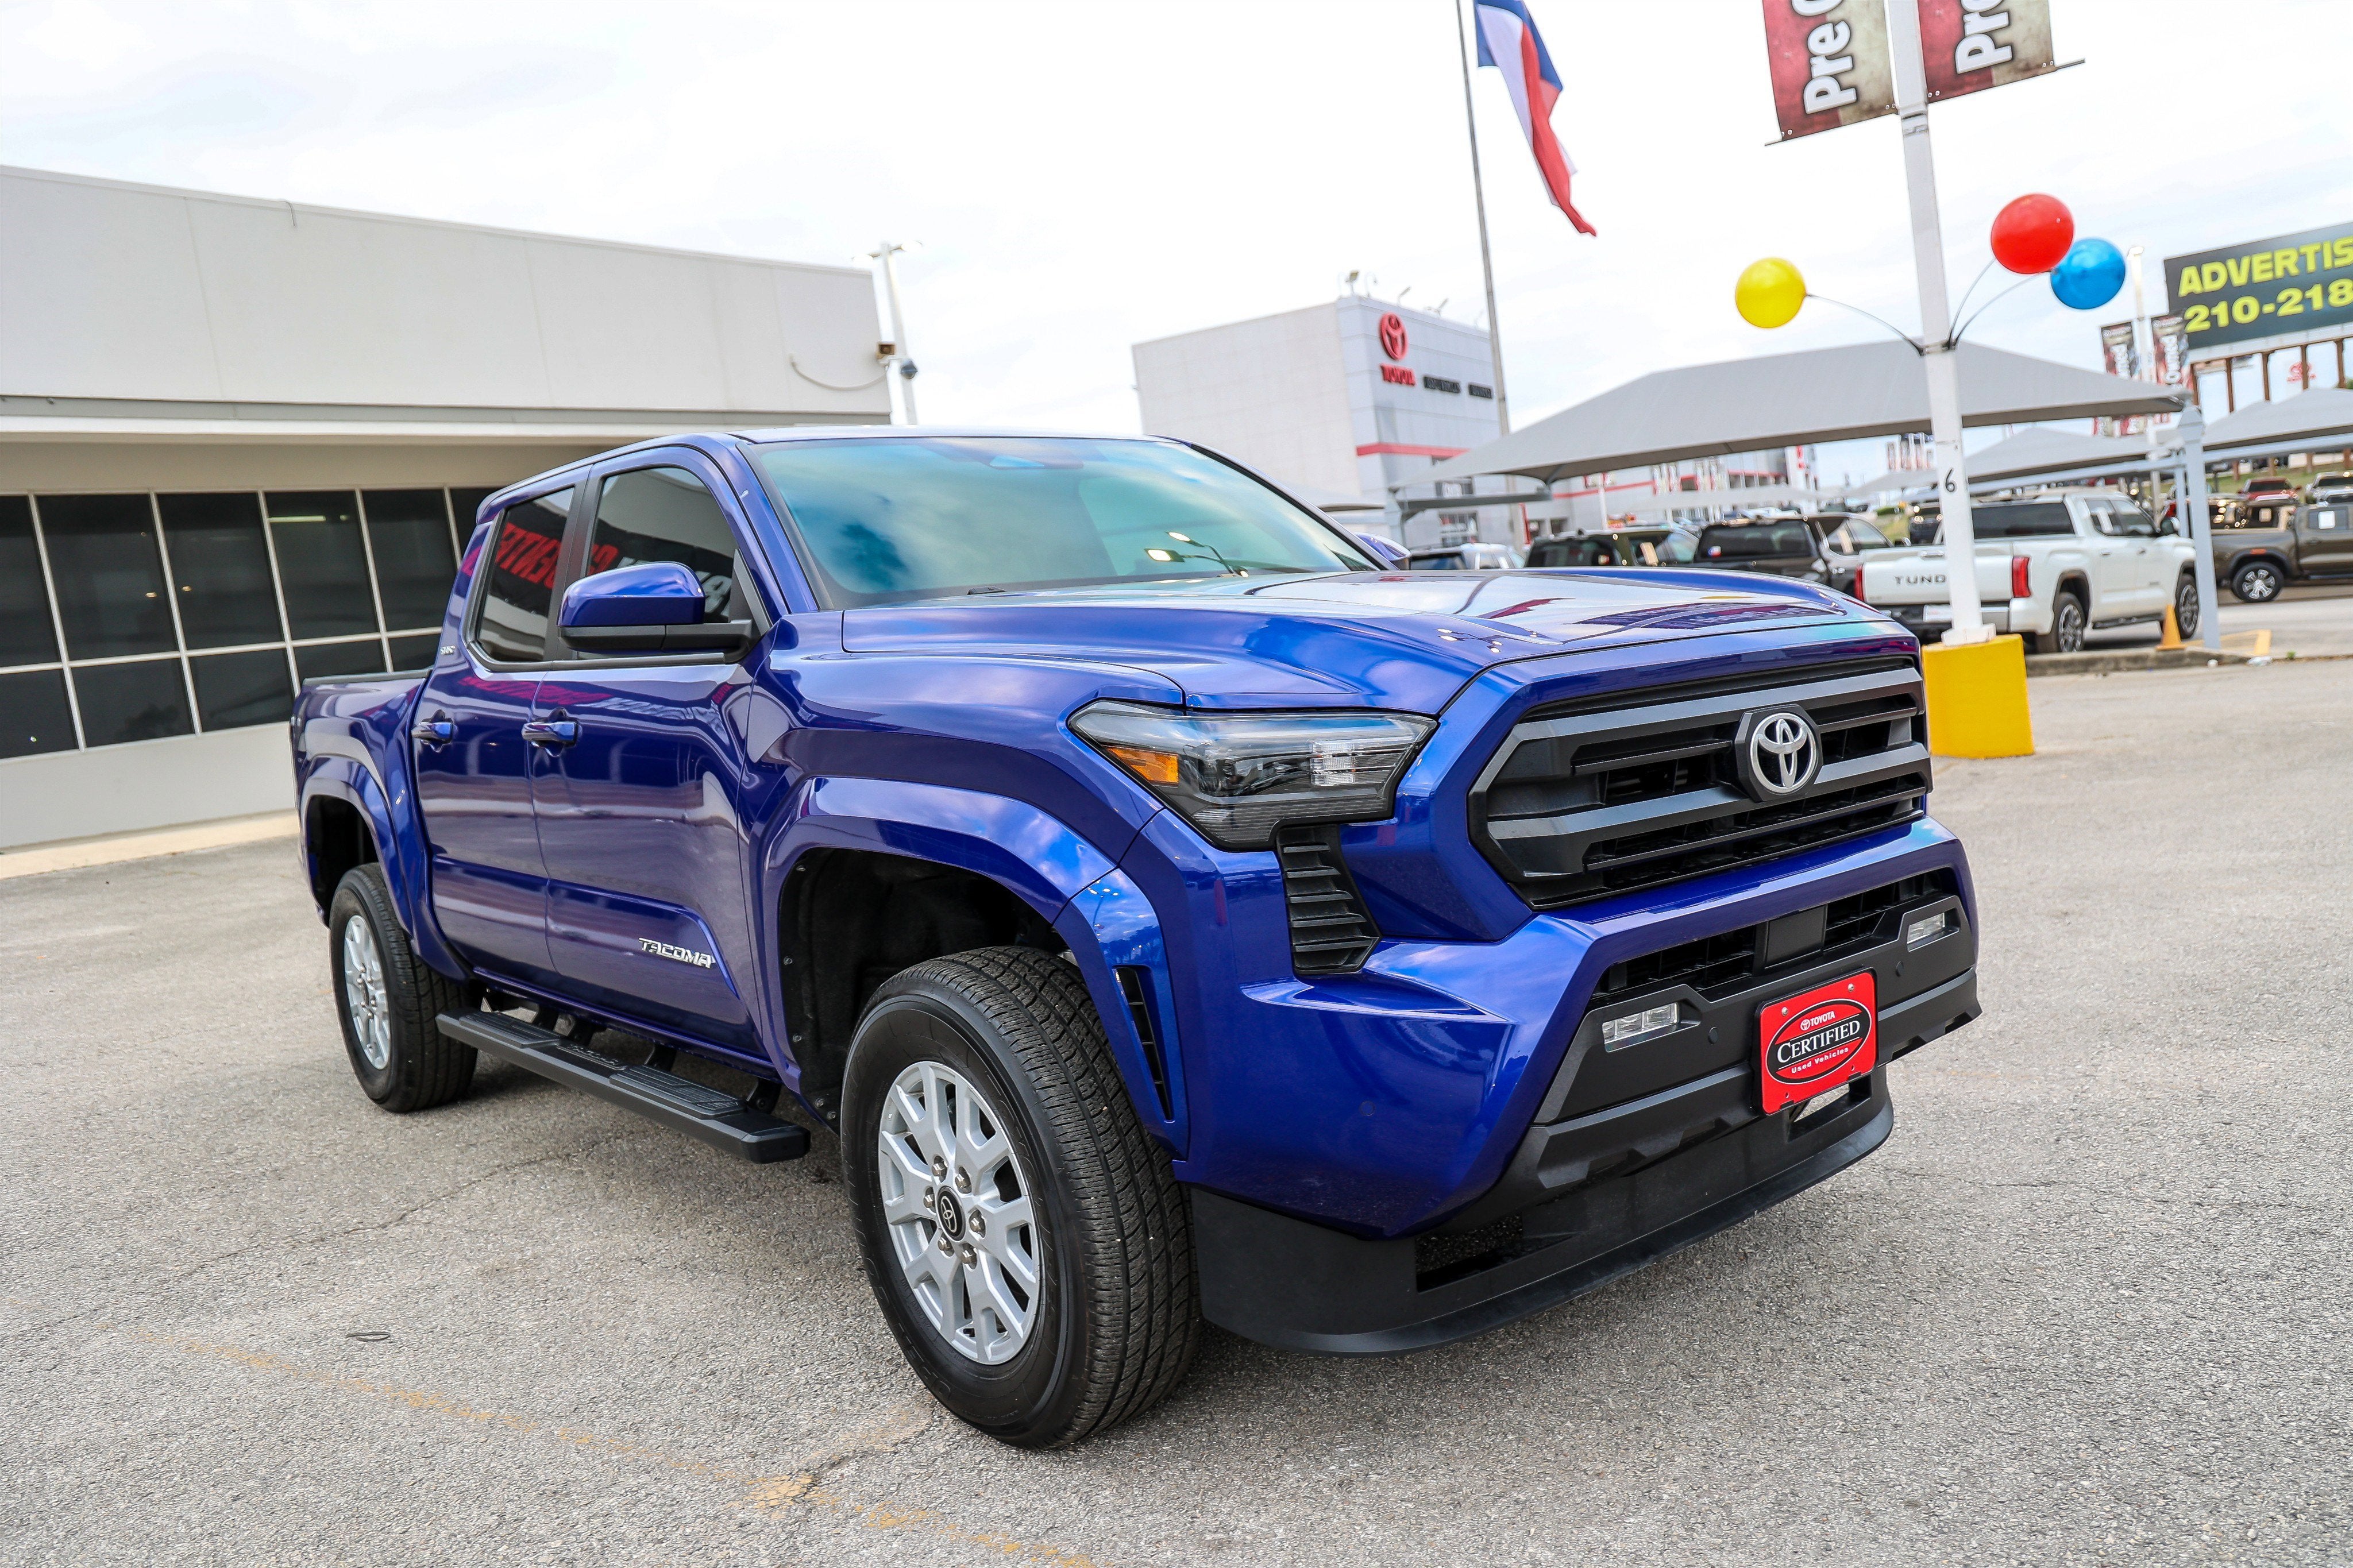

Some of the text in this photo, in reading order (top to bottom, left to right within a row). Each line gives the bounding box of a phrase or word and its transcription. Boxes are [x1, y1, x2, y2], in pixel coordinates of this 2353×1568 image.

[1803, 20, 1858, 114] Pre
[2178, 235, 2353, 298] ADVERTIS
[2184, 278, 2353, 334] 210-218
[1945, 467, 1955, 493] 6
[1894, 574, 1947, 585] TUND
[638, 937, 713, 969] TACOMA
[1810, 1010, 1836, 1027] TOYOTA
[1777, 1020, 1861, 1063] CERTIFIED
[1791, 1047, 1849, 1073] Used Vehicles
